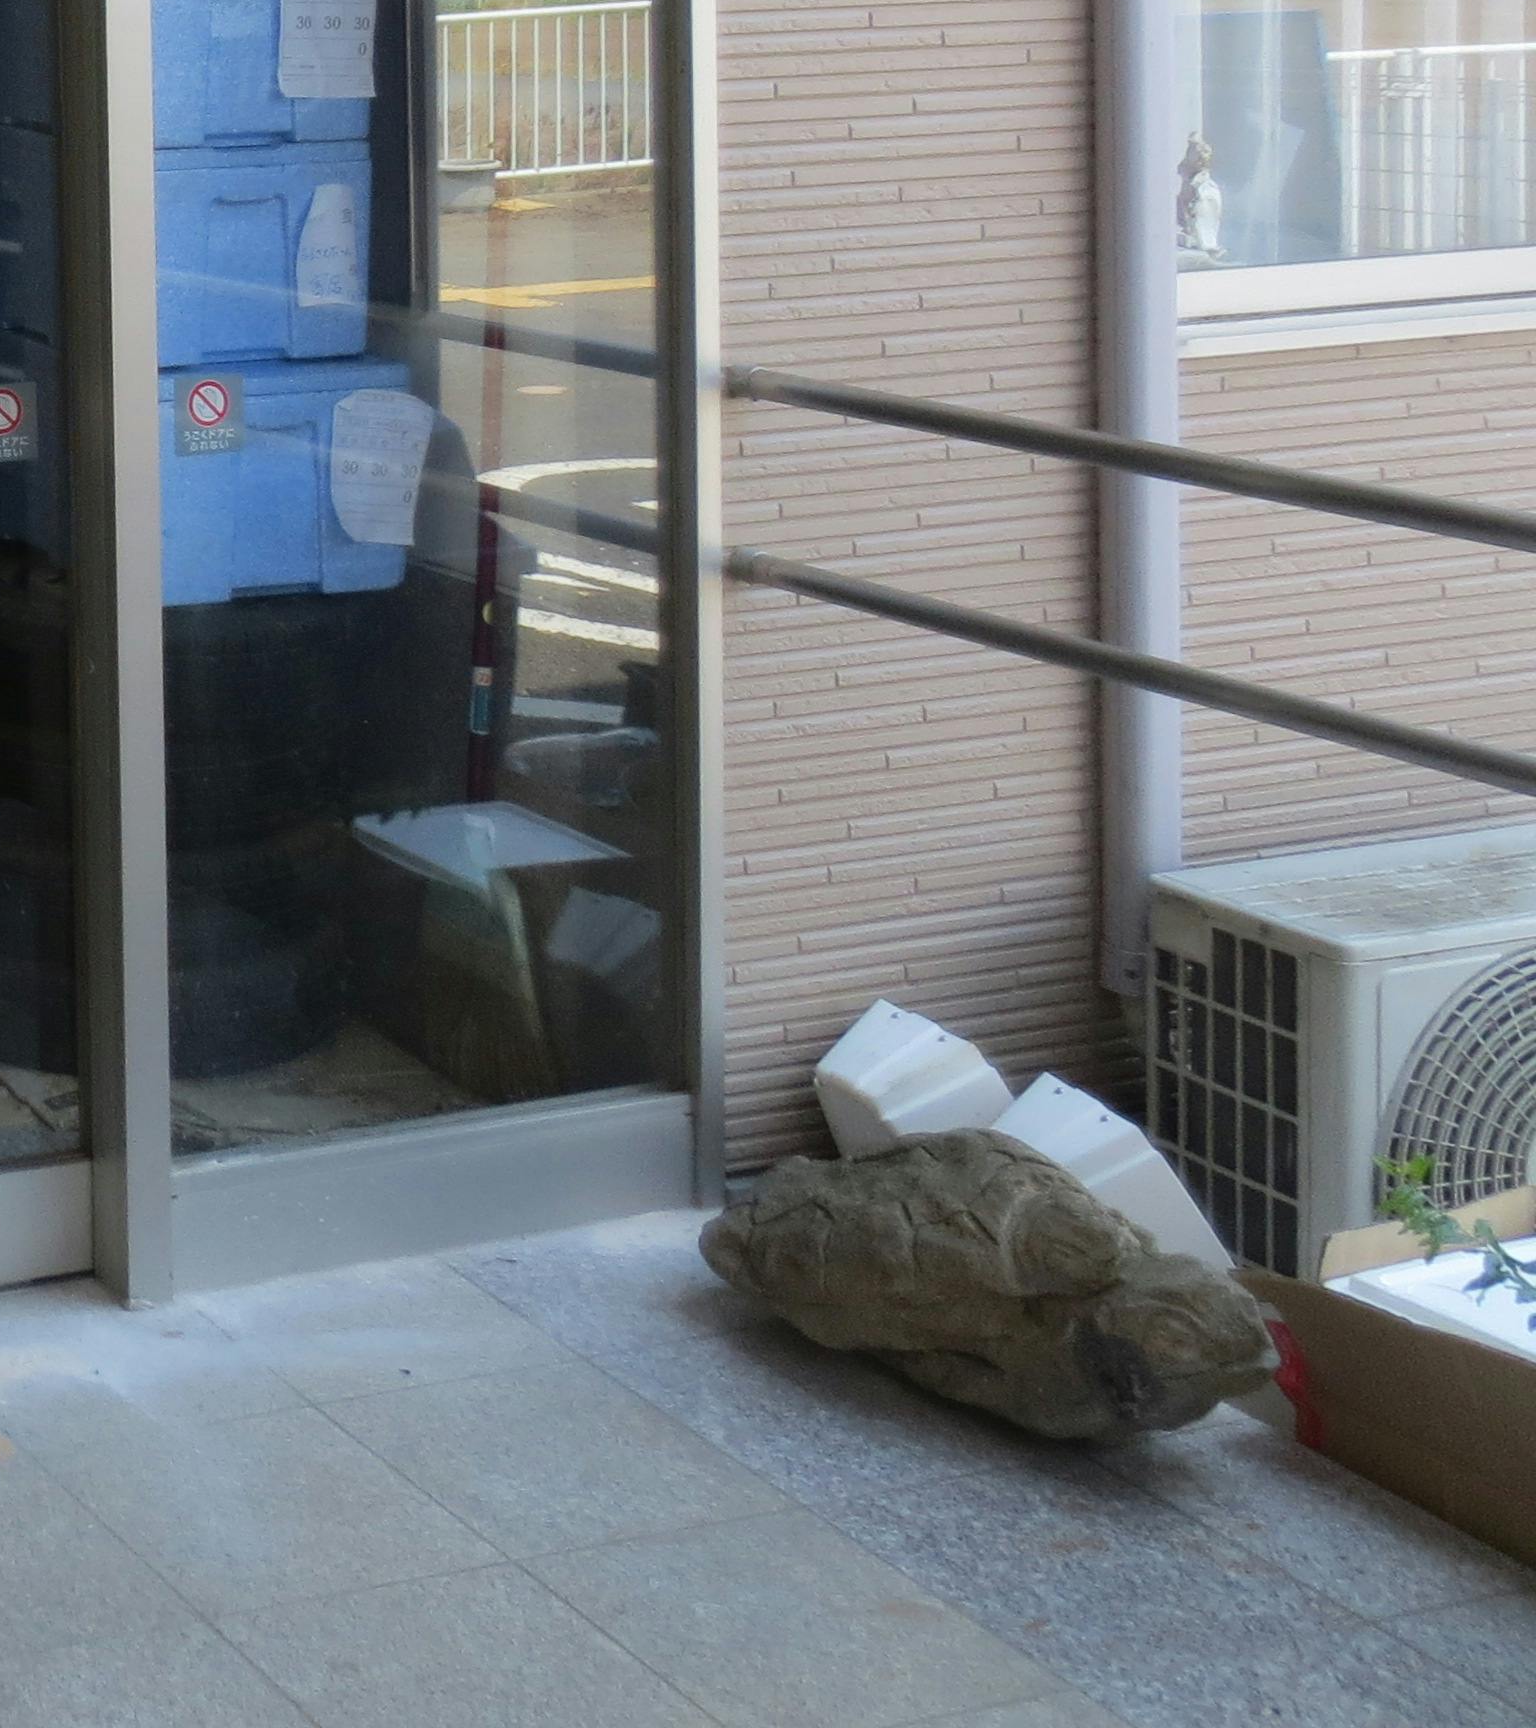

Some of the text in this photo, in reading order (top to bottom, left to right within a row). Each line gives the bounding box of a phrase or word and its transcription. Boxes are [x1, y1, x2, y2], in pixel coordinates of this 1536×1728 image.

[296, 15, 312, 30] 30
[324, 15, 341, 30] 30
[359, 41, 368, 56] 0
